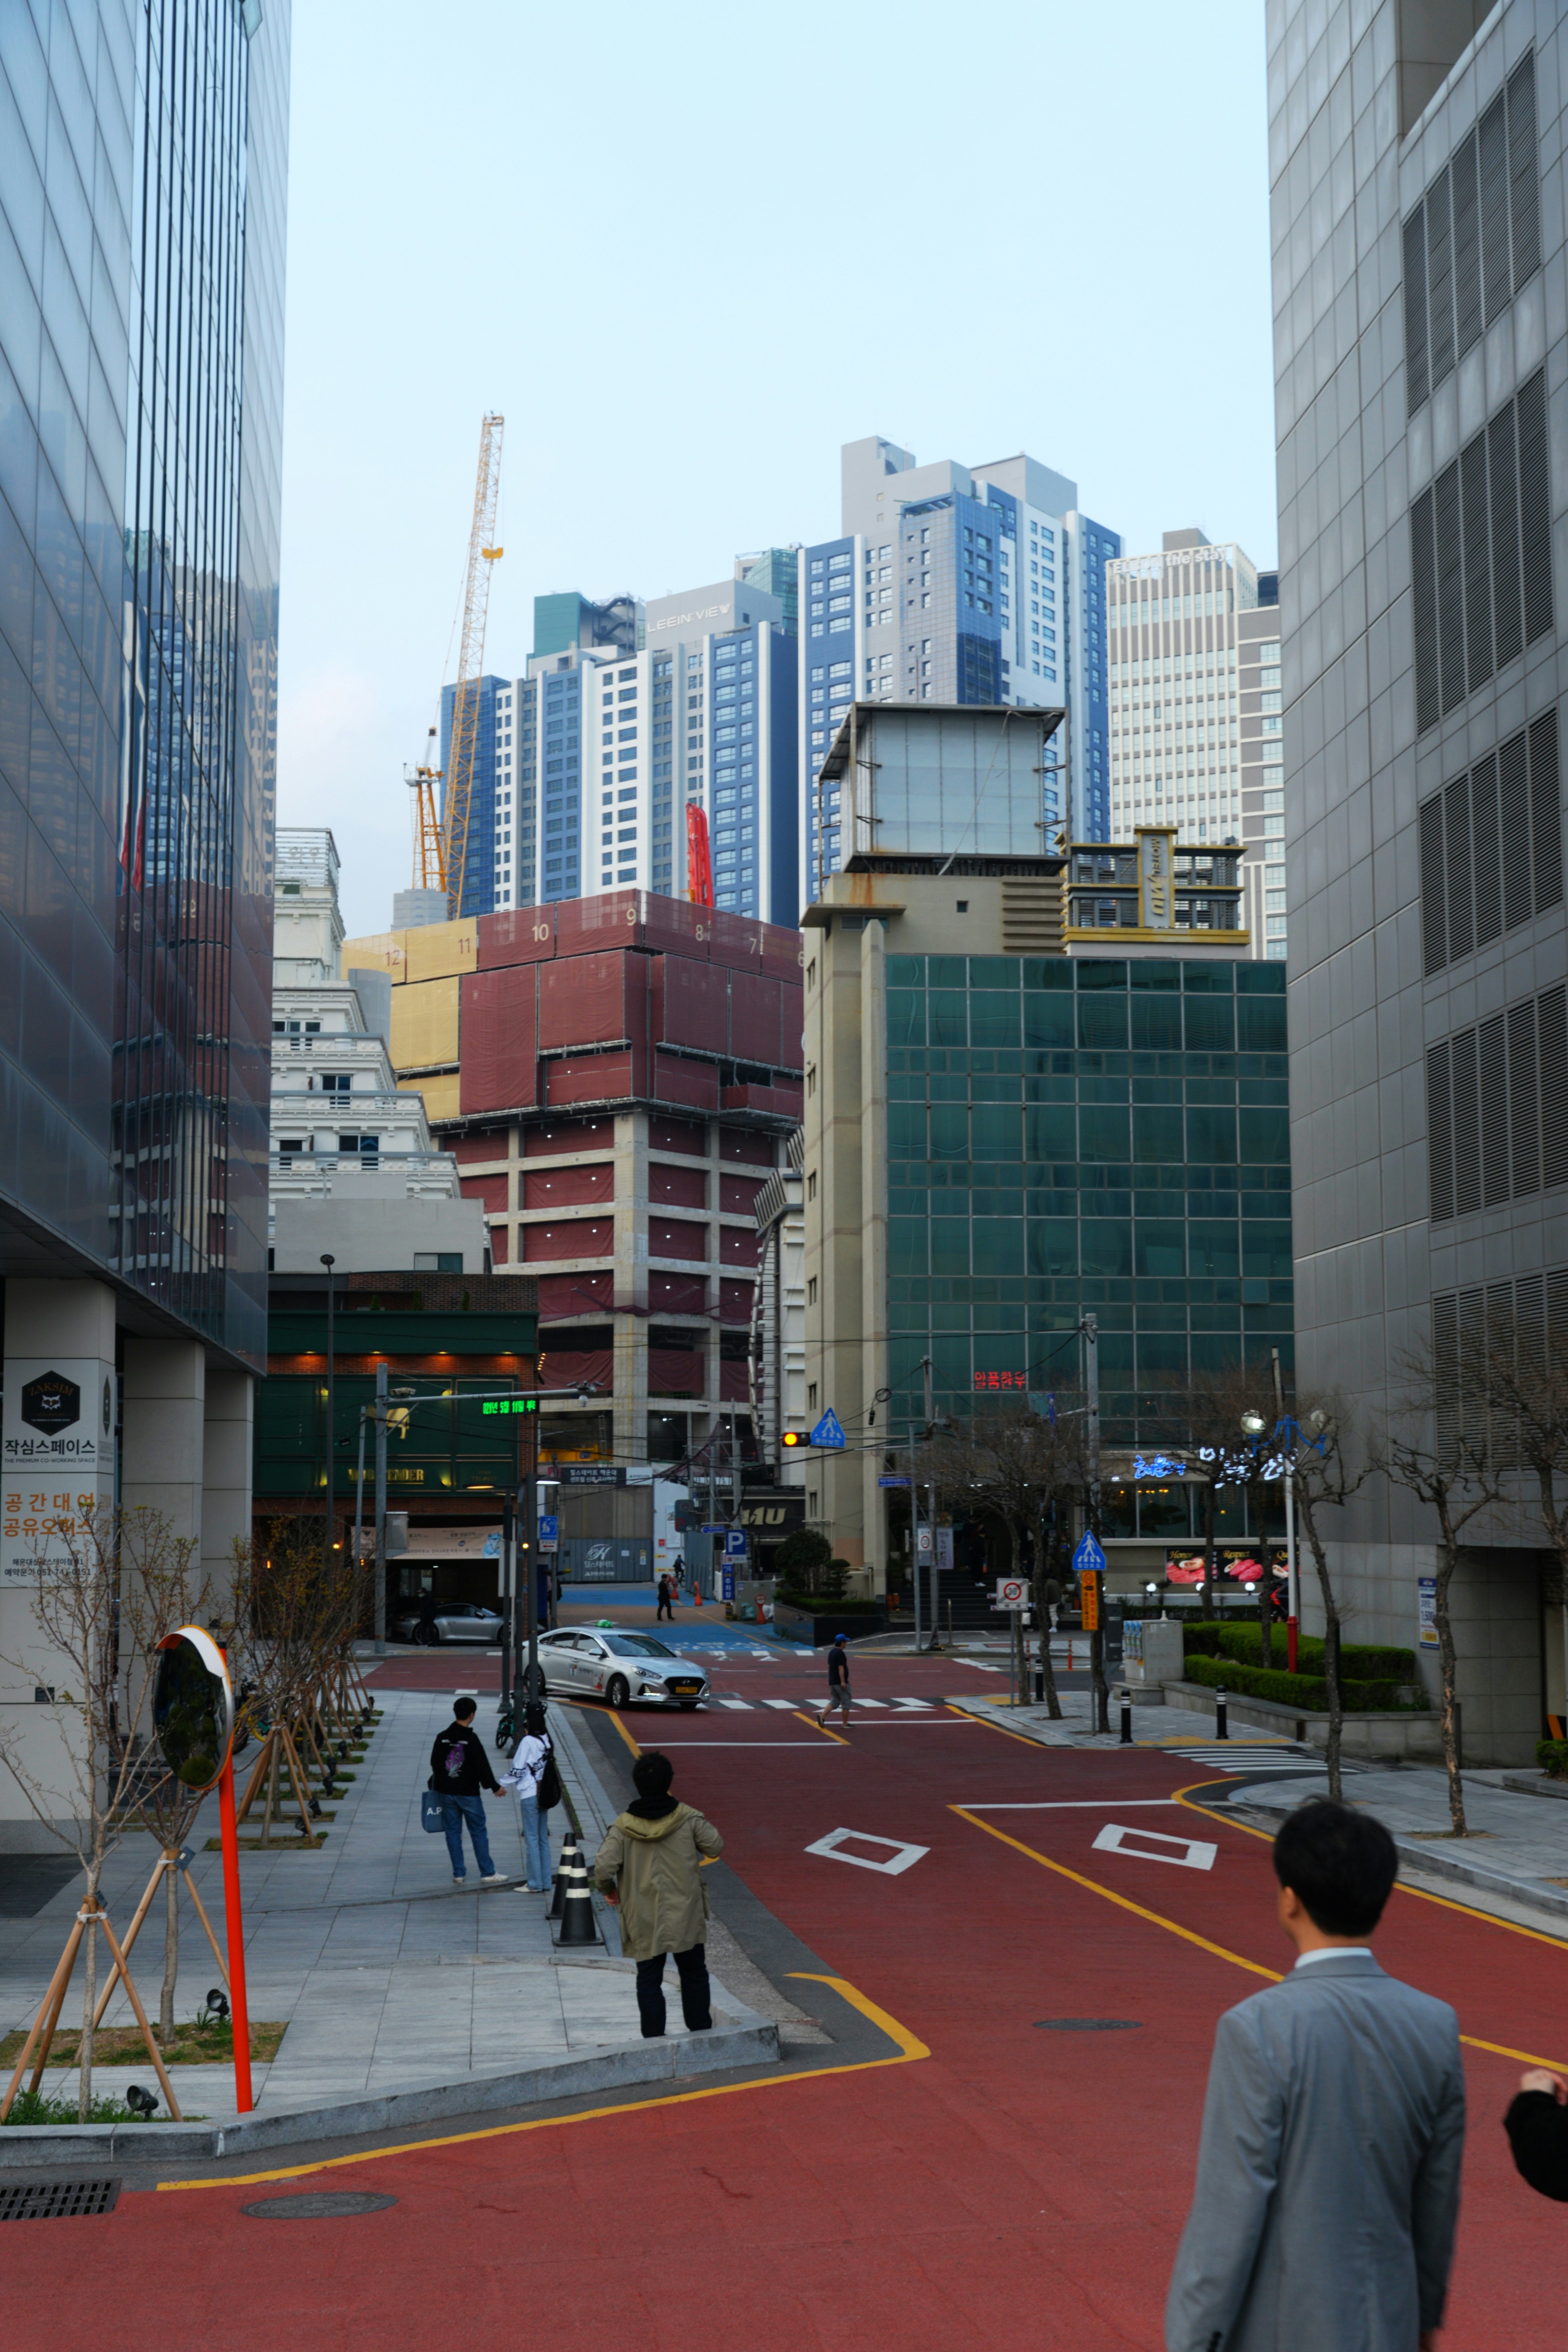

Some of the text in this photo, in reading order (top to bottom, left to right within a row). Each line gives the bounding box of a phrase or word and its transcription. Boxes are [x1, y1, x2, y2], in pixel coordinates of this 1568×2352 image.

[1112, 549, 1226, 574] ELBON the stay
[647, 603, 731, 632] LEEIN VIEW
[1151, 837, 1161, 876] MOTEL
[626, 908, 636, 926] 9
[532, 923, 549, 942] 10
[695, 924, 703, 941] 8
[458, 937, 470, 954] 11
[749, 937, 757, 954] 7
[385, 950, 400, 966] 12
[797, 951, 804, 967] 6
[27, 1382, 74, 1397] ZAKSIM
[974, 1371, 1026, 1390] 일품한우
[5, 1438, 96, 1455] 작심스페이스
[3, 1517, 92, 1537] 공유오피스
[728, 1532, 744, 1552] P
